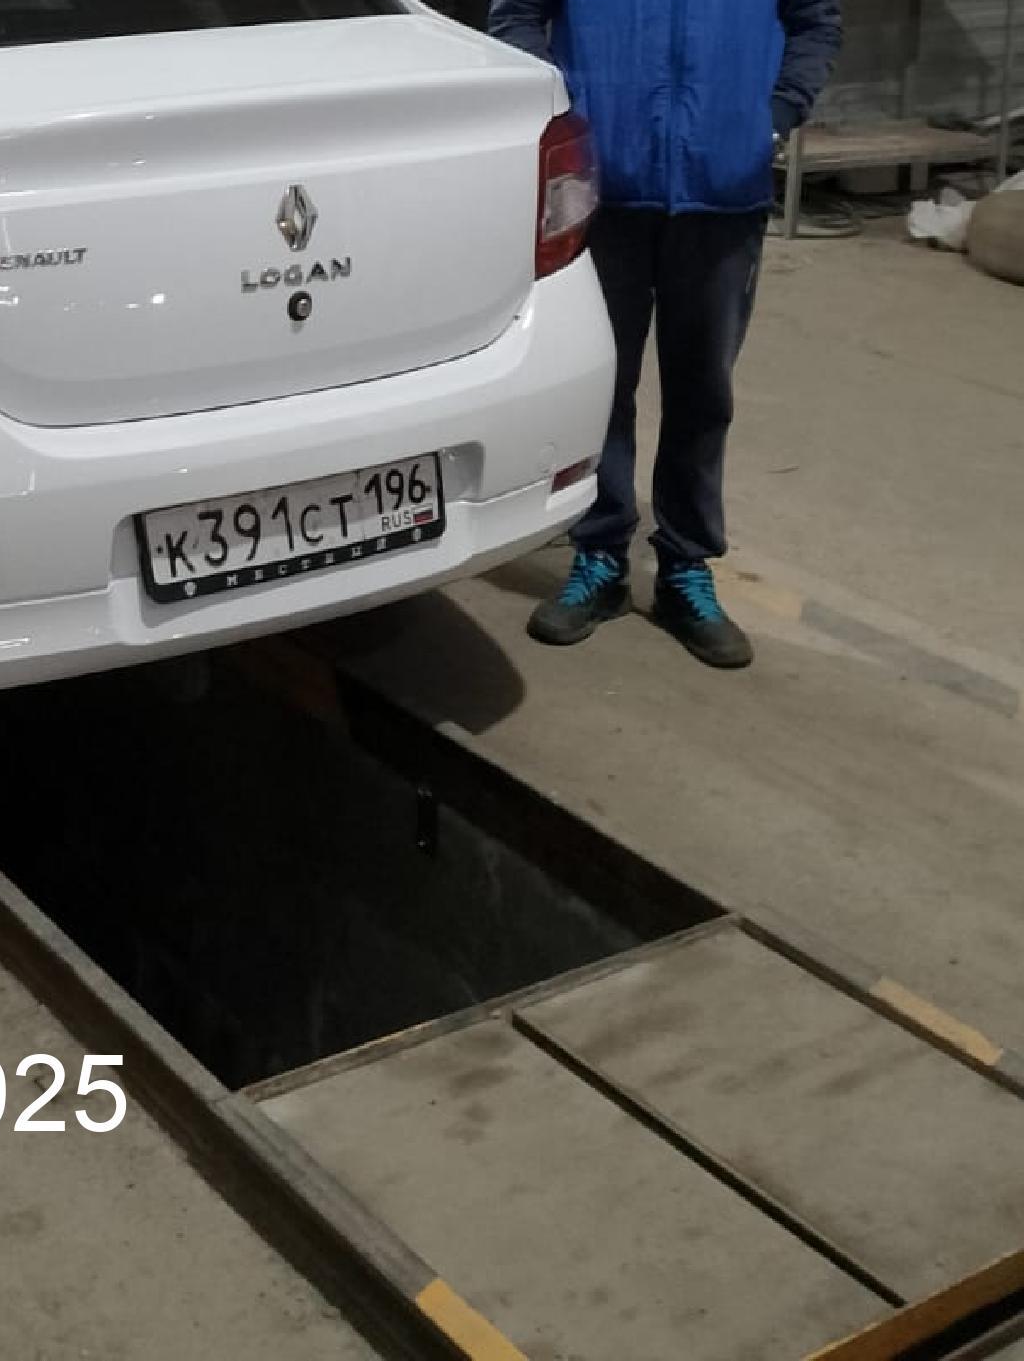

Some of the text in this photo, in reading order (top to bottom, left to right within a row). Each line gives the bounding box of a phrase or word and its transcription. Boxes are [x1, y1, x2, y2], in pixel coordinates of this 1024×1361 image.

[241, 257, 351, 293] LOGAN
[365, 463, 428, 515] 196
[381, 509, 412, 533] RUS
